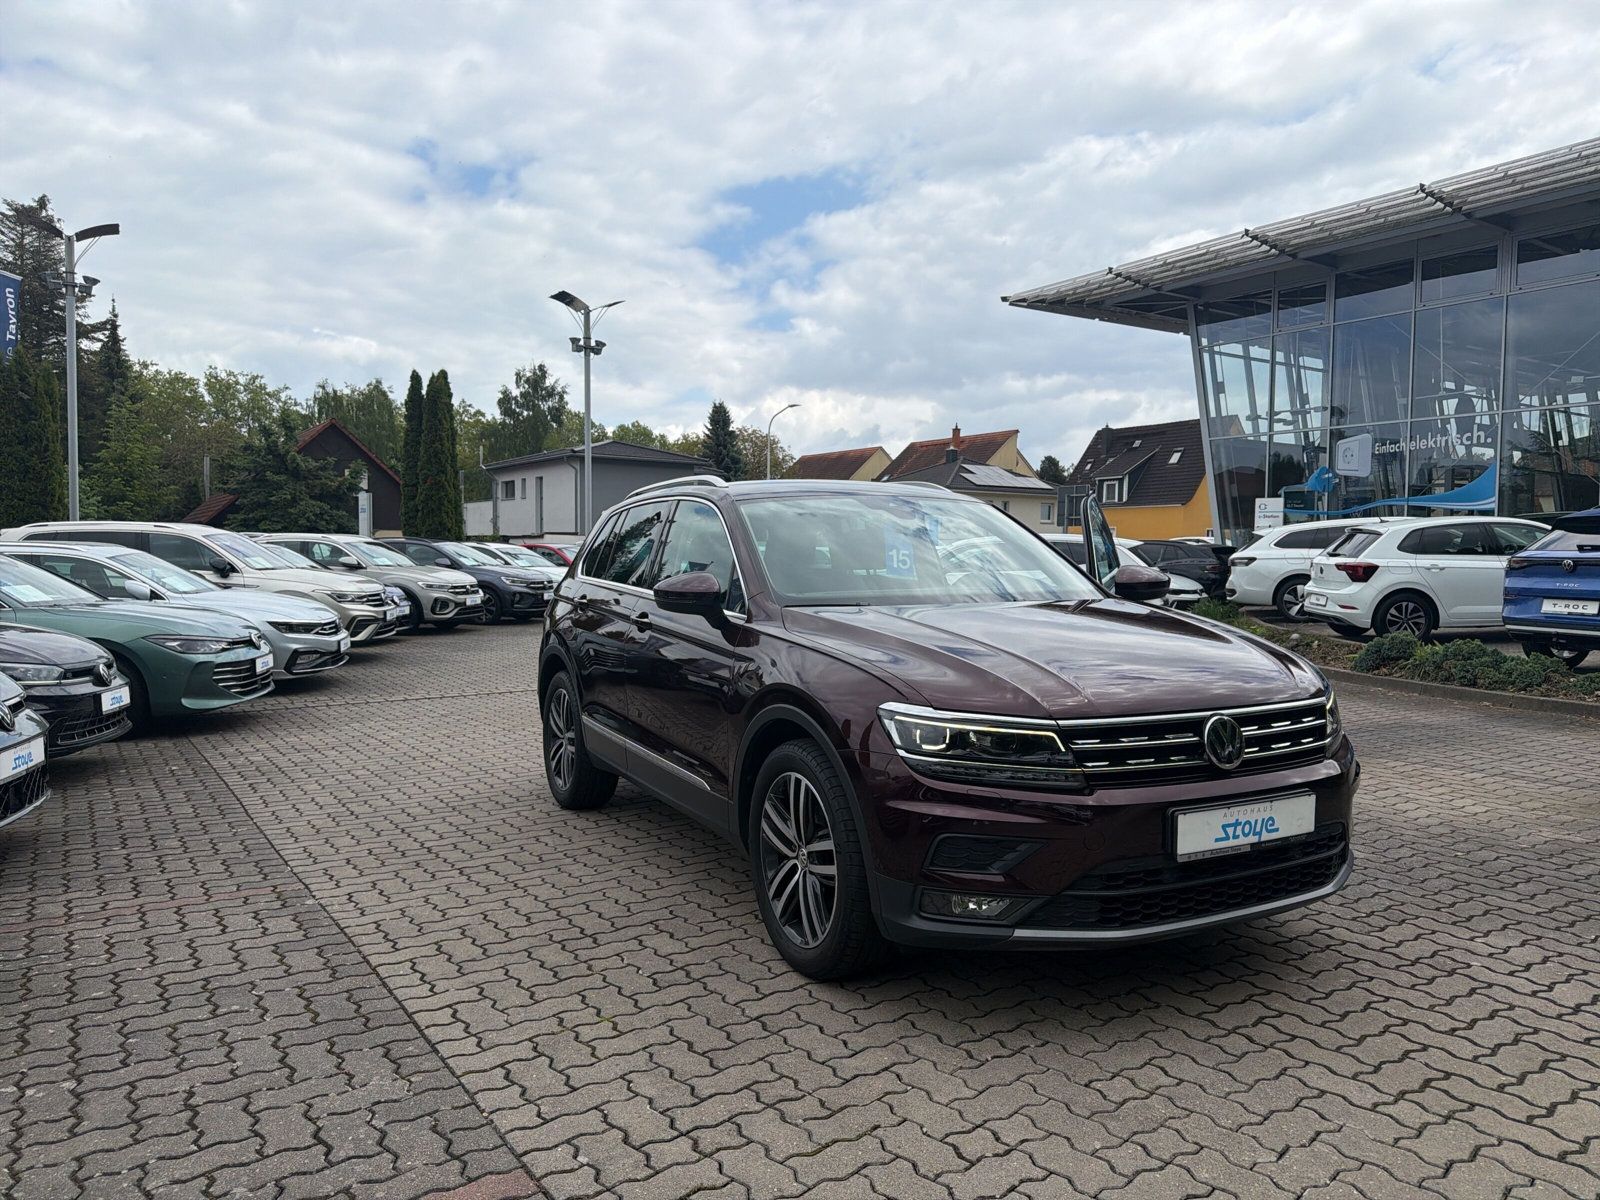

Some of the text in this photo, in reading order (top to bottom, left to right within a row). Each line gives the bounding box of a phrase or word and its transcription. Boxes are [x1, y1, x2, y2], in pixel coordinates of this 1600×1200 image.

[5, 287, 17, 342] Tayron
[1374, 424, 1492, 454] Einfach elektrisch.
[888, 549, 911, 569] 15
[1223, 804, 1274, 819] AUTOHAUS
